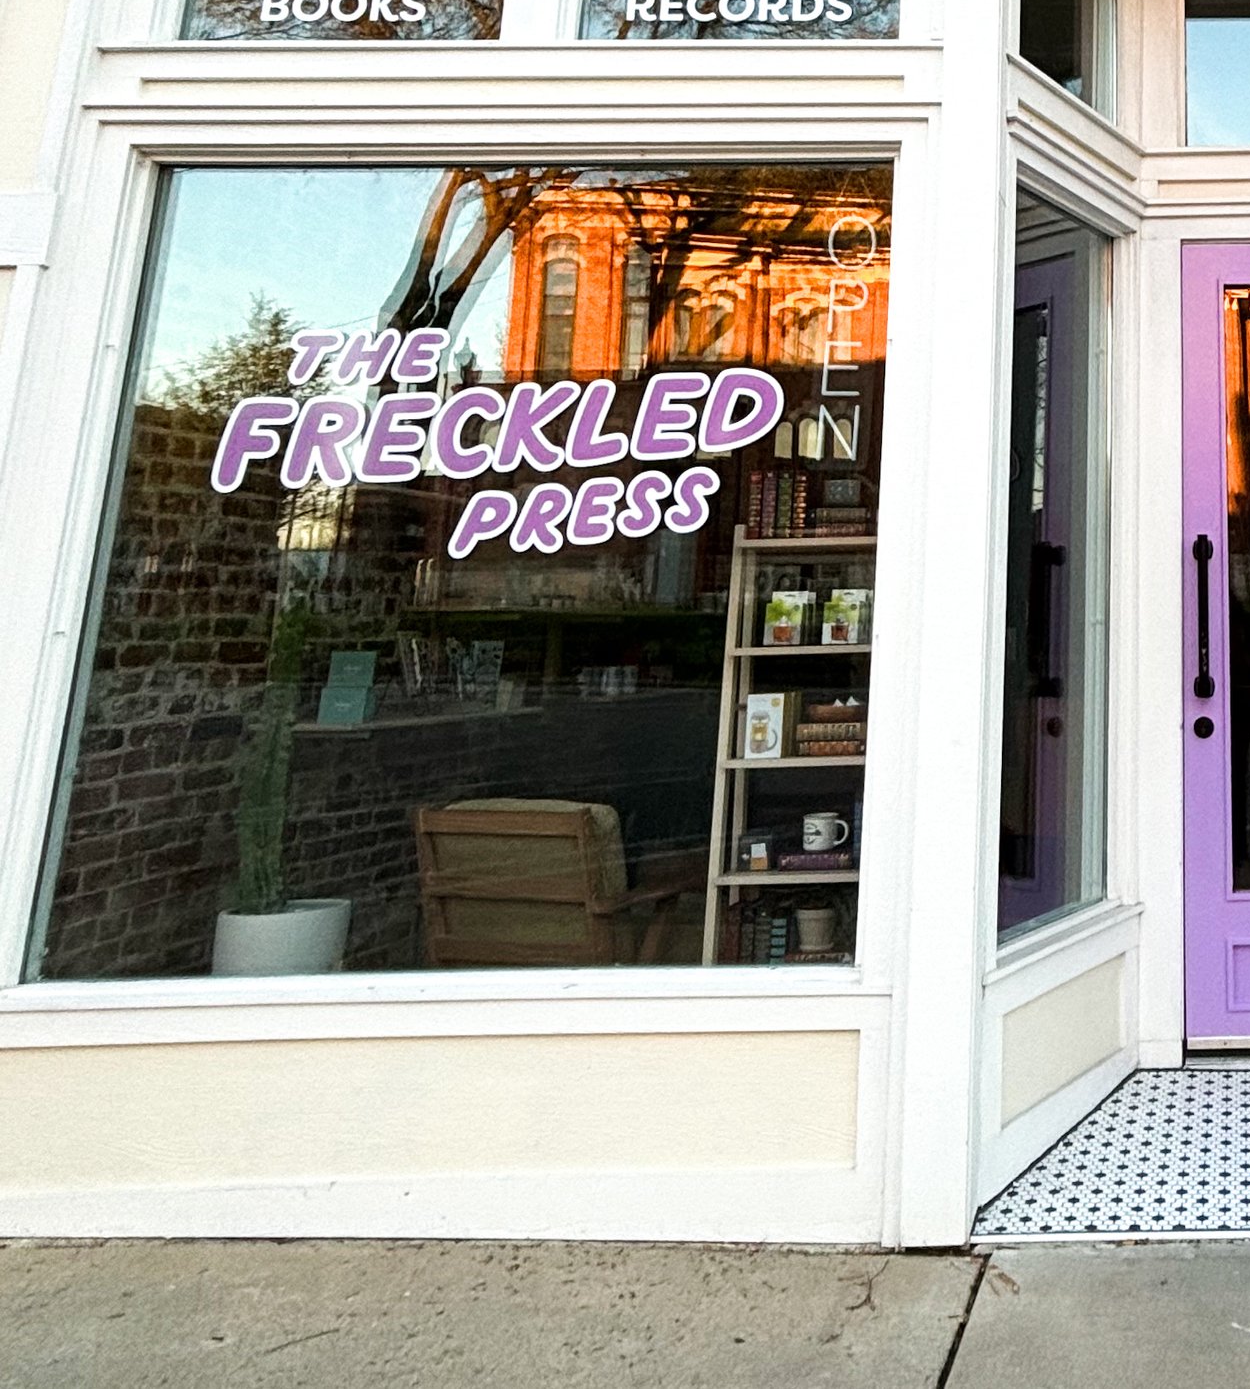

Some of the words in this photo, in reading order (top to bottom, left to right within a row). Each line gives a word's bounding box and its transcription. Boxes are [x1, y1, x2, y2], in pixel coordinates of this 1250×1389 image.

[287, 327, 450, 386] THE
[816, 215, 877, 461] OPEN
[210, 367, 785, 494] FRECKLED
[447, 466, 720, 560] PRESS
